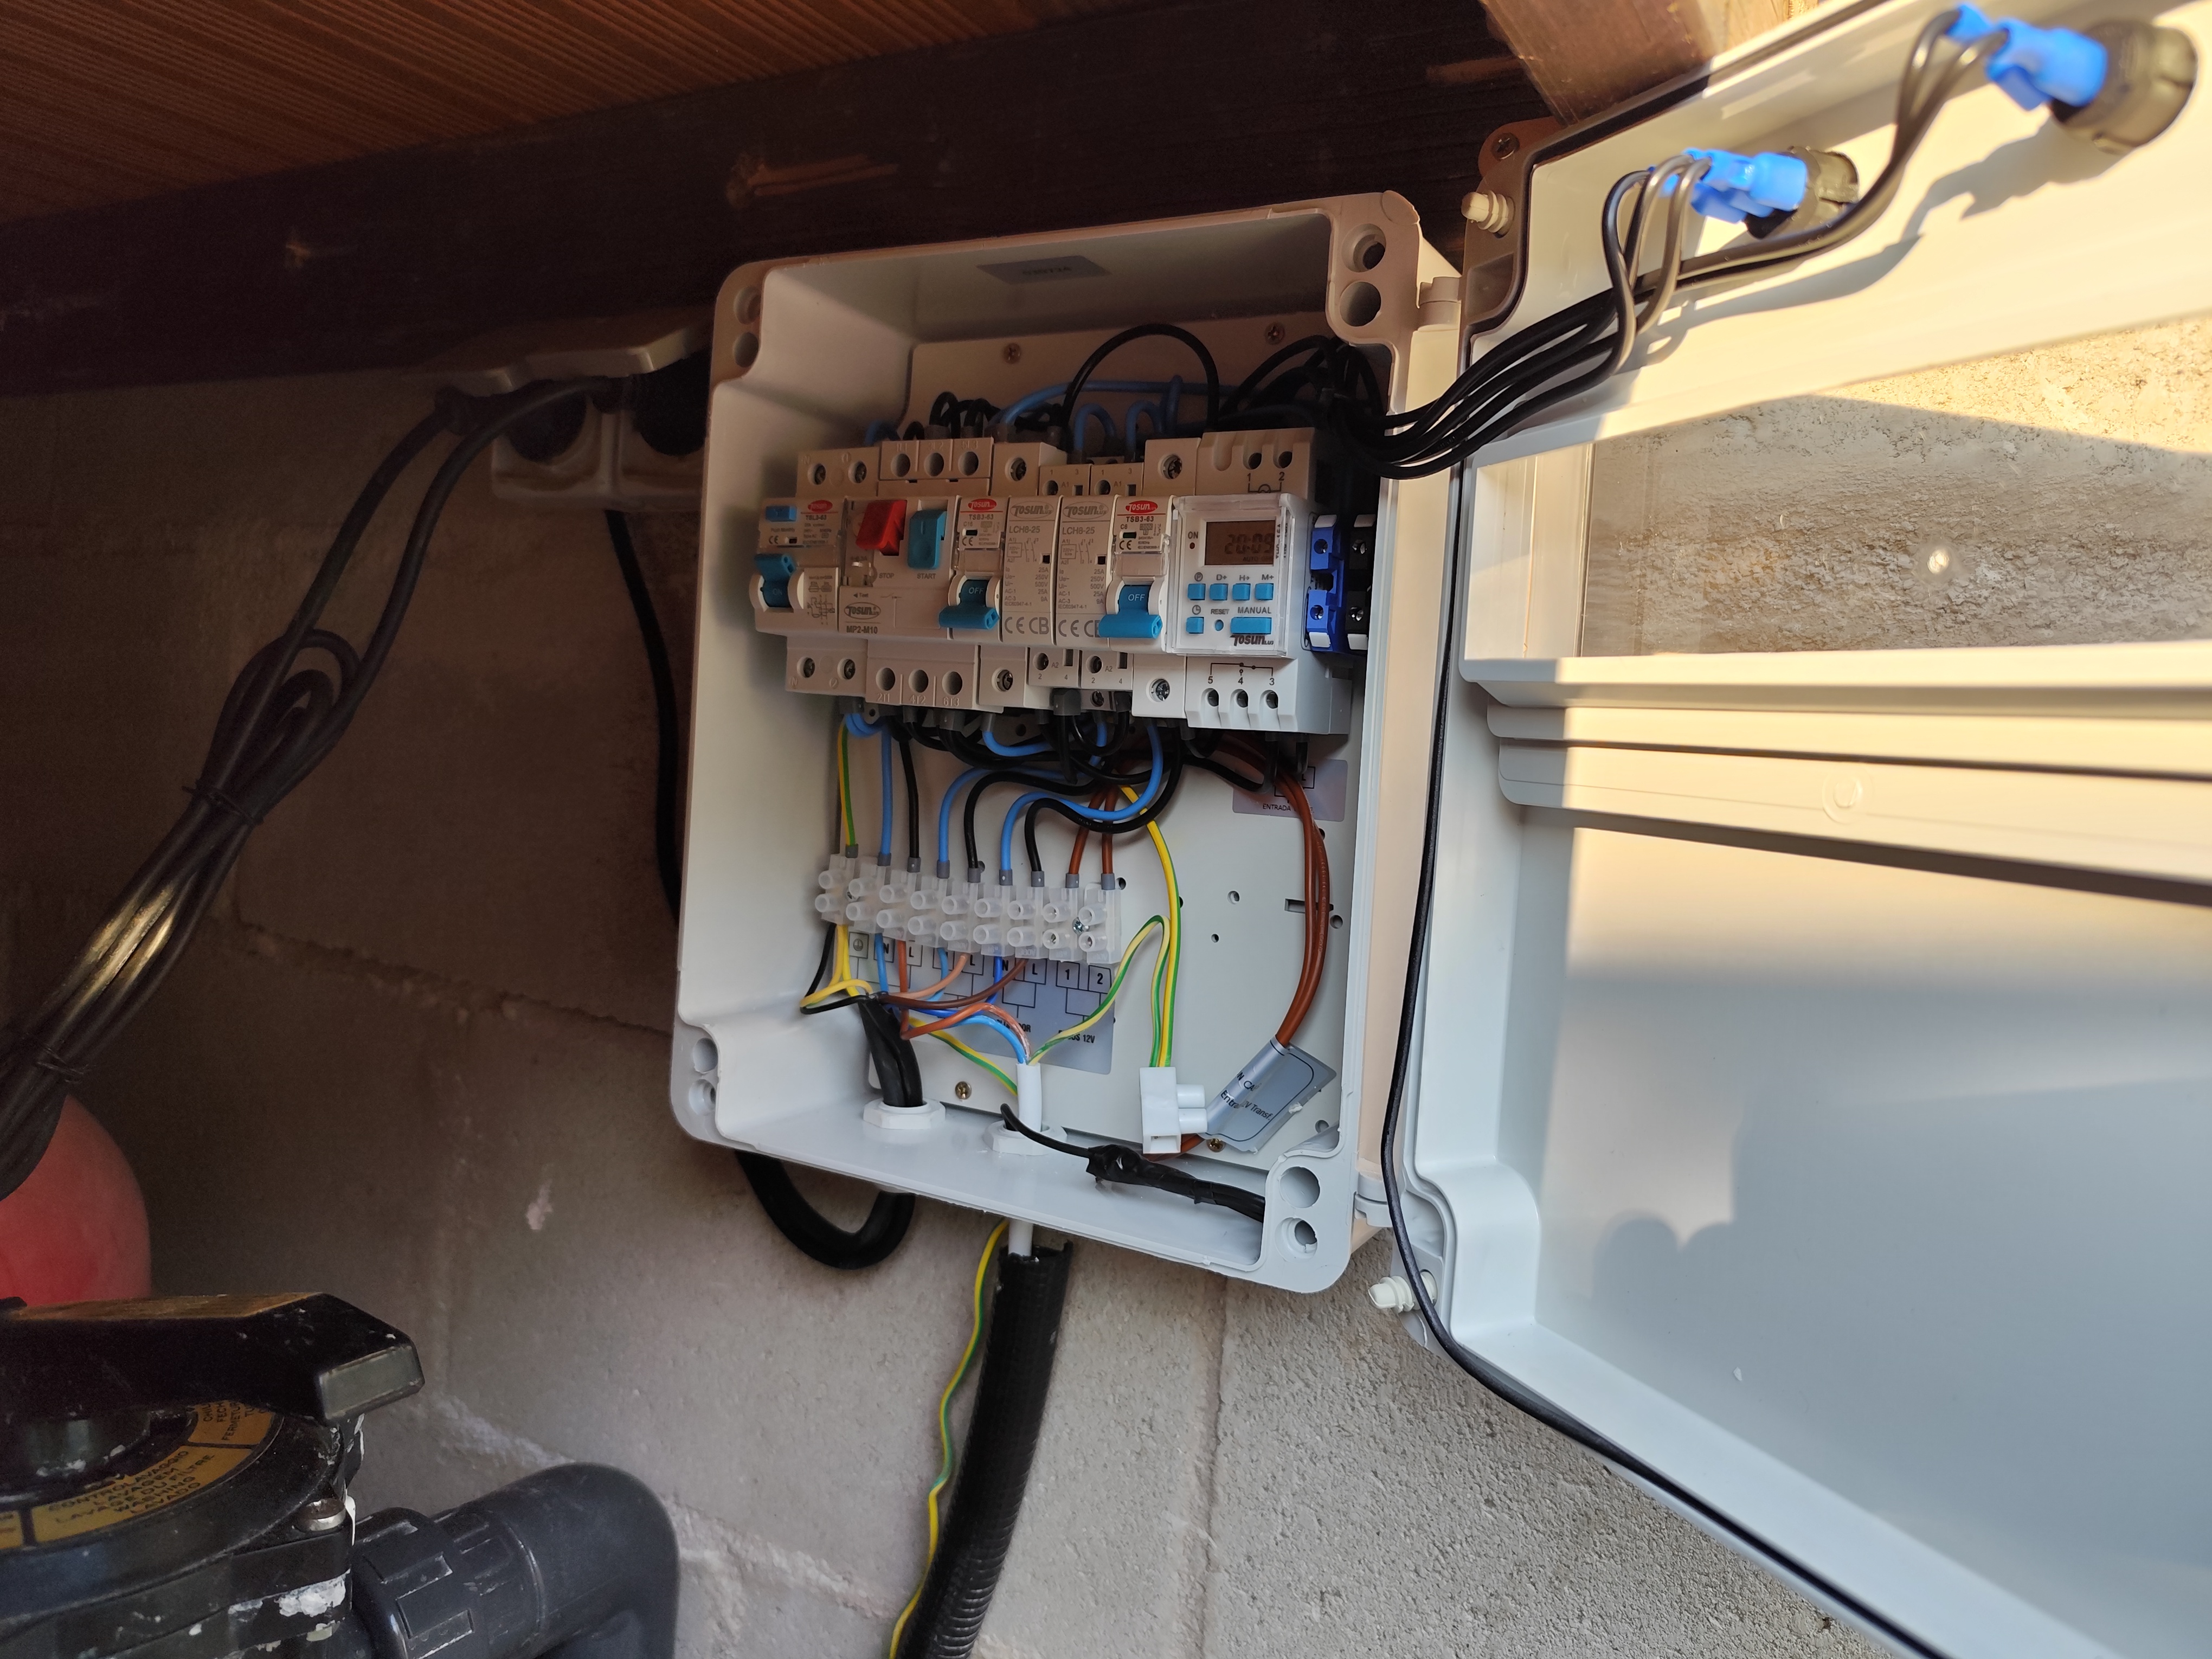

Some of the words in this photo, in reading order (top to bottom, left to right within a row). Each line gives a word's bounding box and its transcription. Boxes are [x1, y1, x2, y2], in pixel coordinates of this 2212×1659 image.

[1247, 473, 1251, 482] 1
[1278, 471, 1285, 481] 2
[1009, 525, 1040, 533] LCH8-25
[1062, 526, 1095, 535] LCH8-25
[1188, 531, 1199, 539] ON
[1237, 606, 1272, 614] MANUAL
[846, 625, 878, 634] MP2-M10
[1207, 676, 1213, 684] 5
[1238, 677, 1244, 685] 4
[1269, 678, 1275, 686] 3
[1262, 803, 1291, 811] ENTRADA
[909, 946, 914, 957] L
[970, 954, 975, 966] L
[1002, 960, 1009, 972] N
[1032, 963, 1038, 975] L
[1065, 969, 1070, 980] 1
[1097, 973, 1103, 985] 2
[1083, 1034, 1095, 1044] 12V
[1250, 1104, 1273, 1121] Transf.
